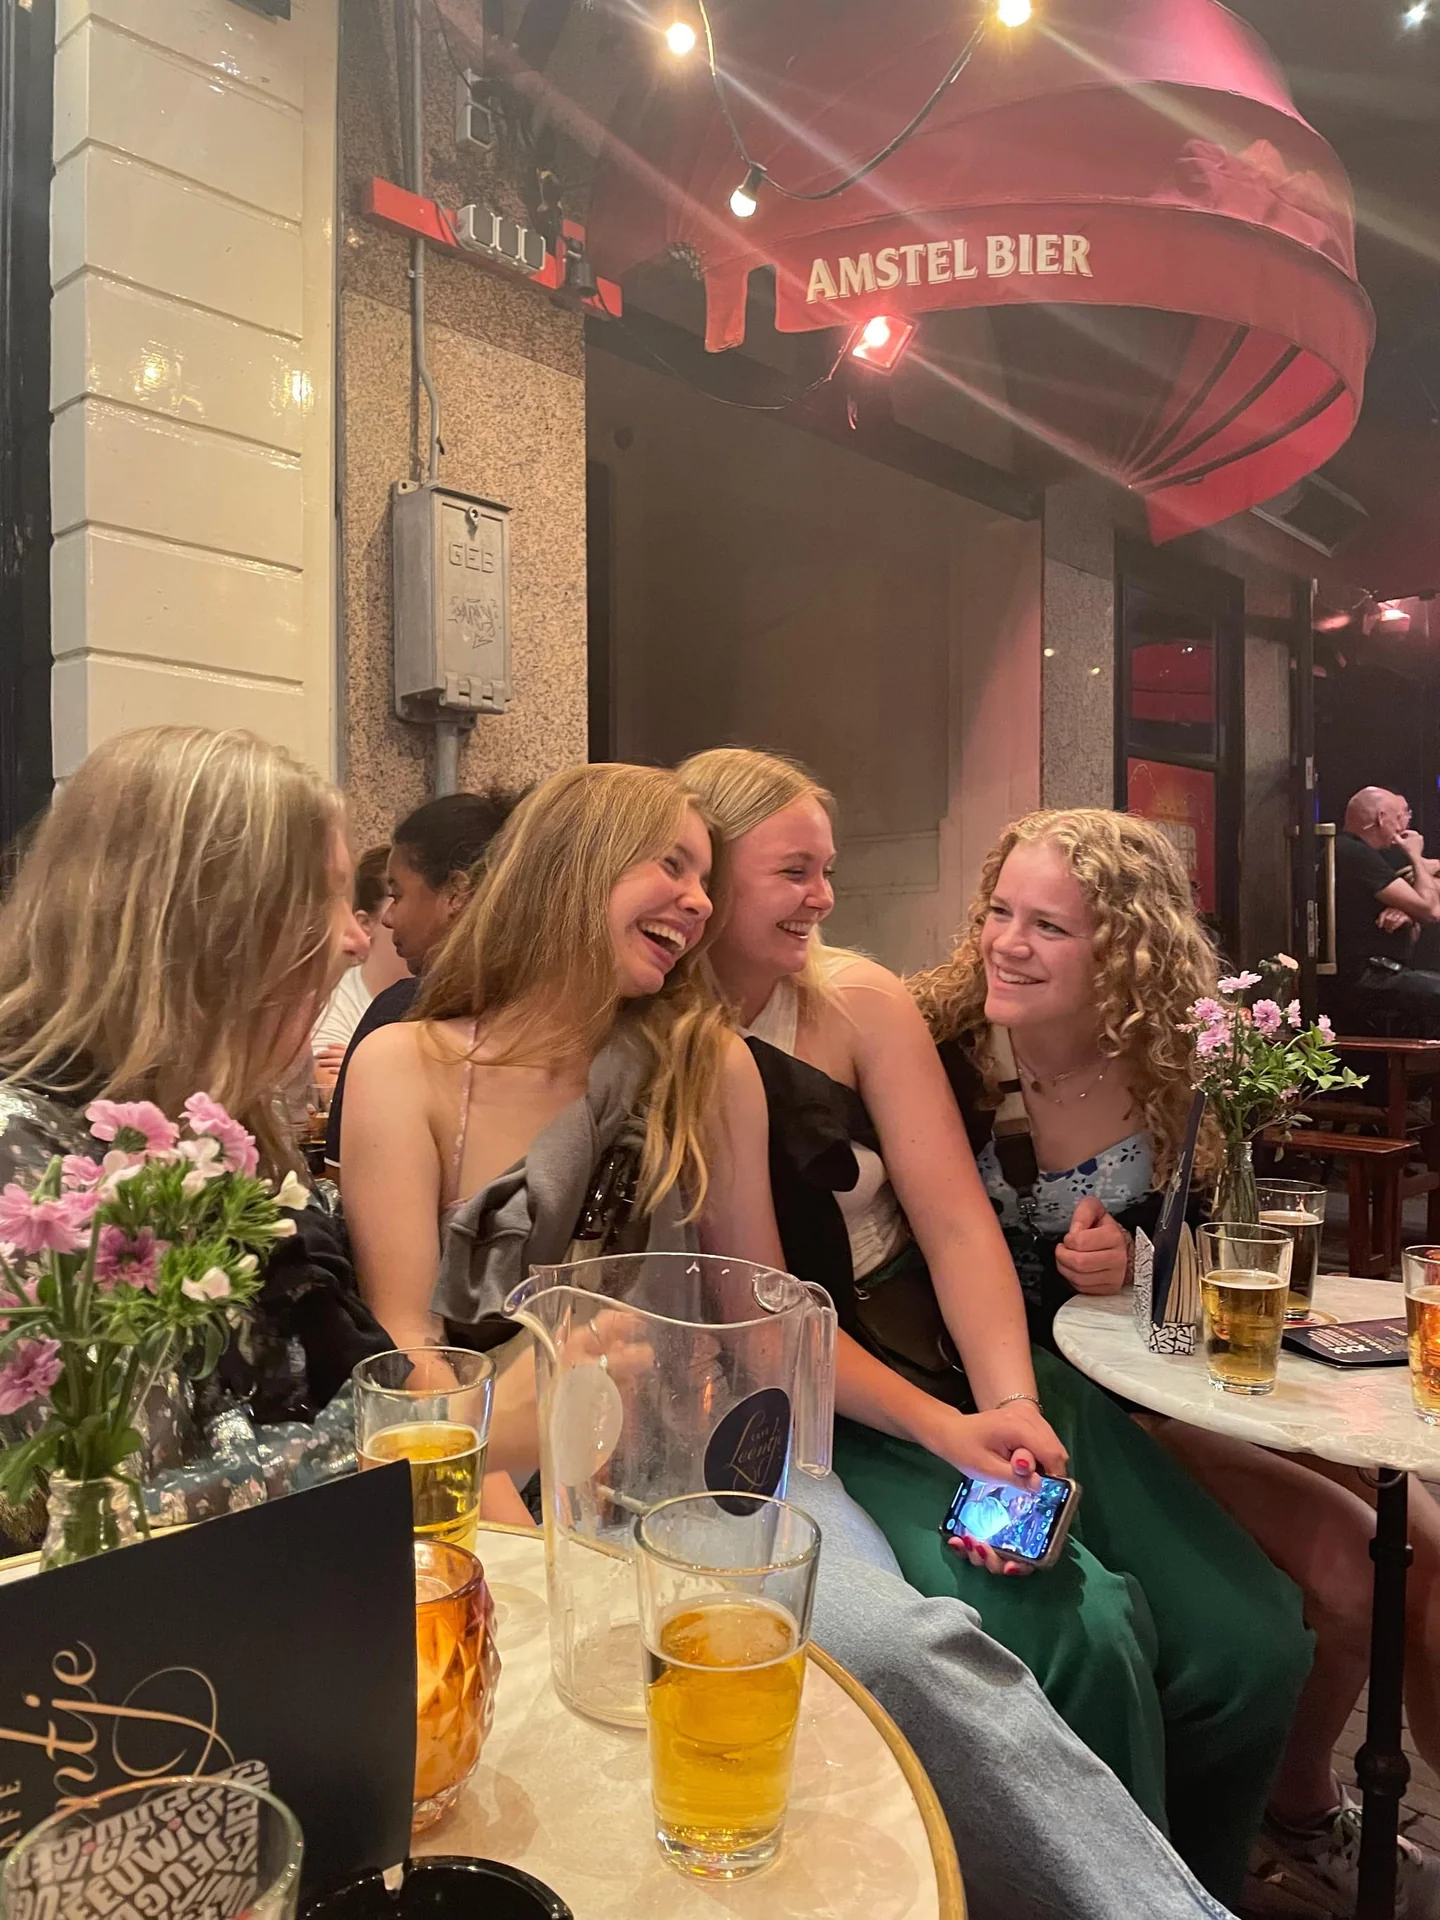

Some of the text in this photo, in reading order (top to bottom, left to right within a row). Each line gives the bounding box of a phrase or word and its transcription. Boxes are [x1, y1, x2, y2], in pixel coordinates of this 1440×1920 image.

[806, 233, 1094, 304] AMSTEL BIER
[448, 541, 494, 574] GEB
